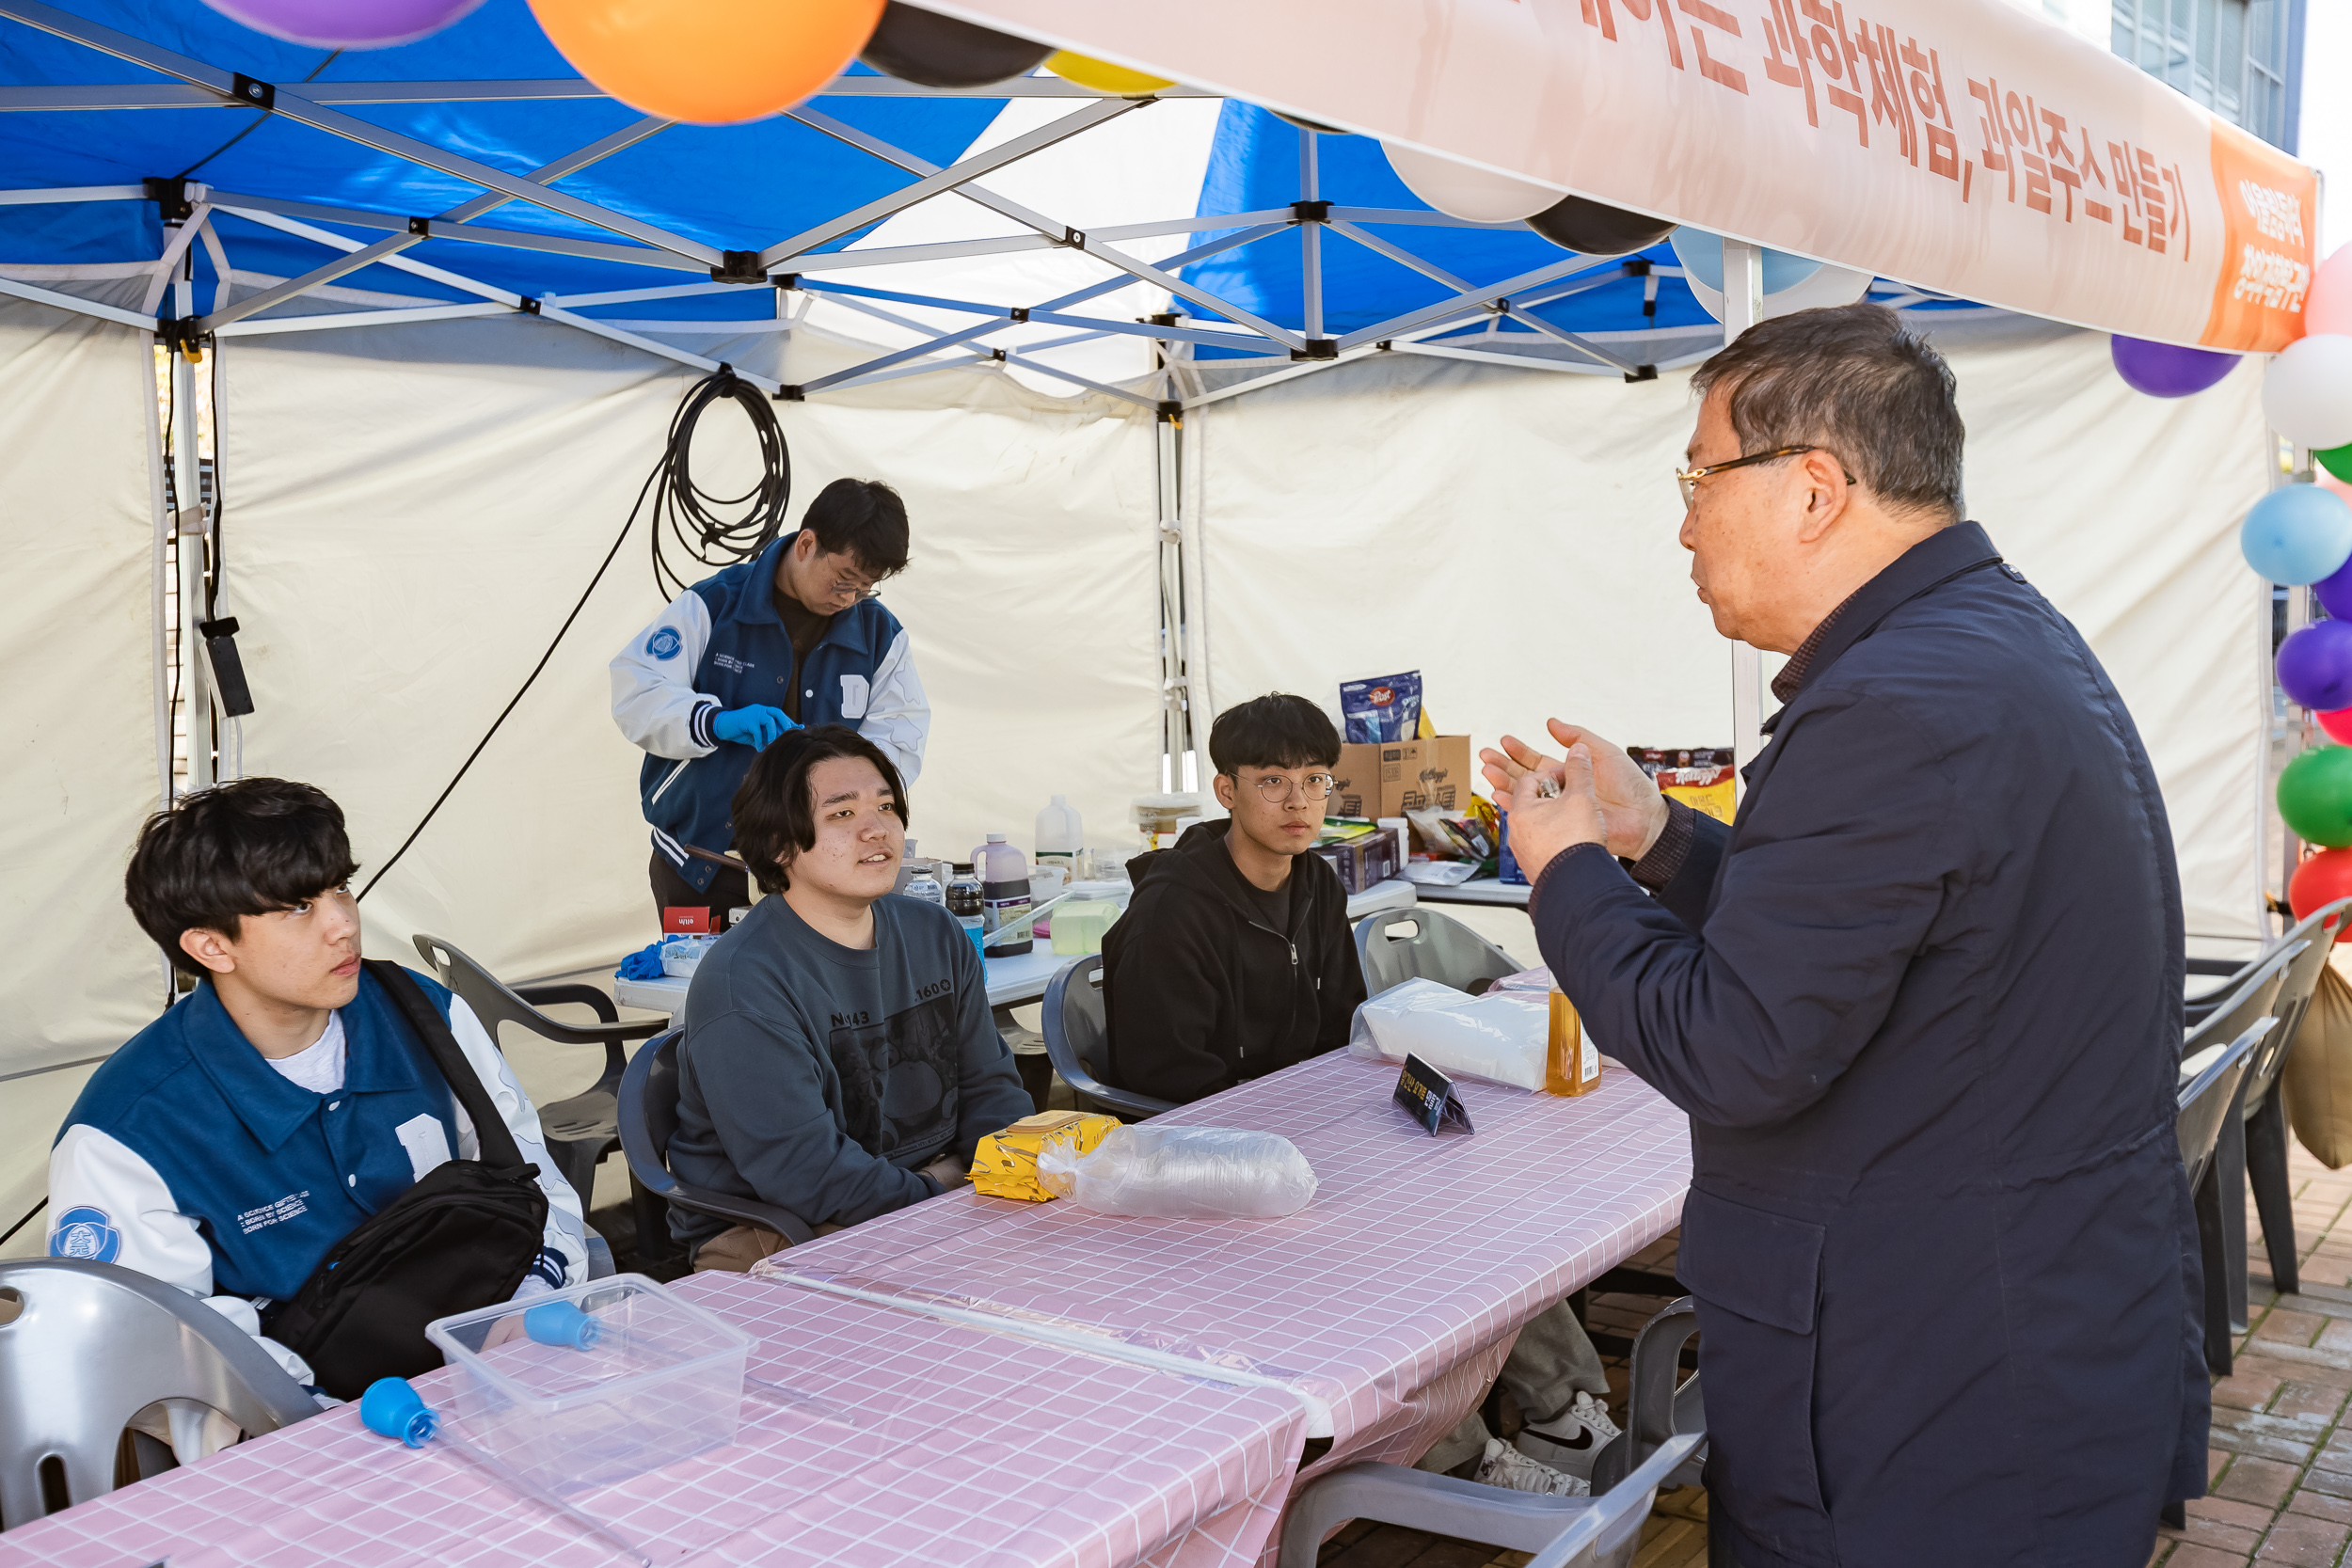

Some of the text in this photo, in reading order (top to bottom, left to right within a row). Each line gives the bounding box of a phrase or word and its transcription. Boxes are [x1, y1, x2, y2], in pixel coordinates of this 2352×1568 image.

[244, 1204, 275, 1218] SCIENCE
[275, 1195, 298, 1208] GIFTE
[276, 1199, 304, 1215] SCIENCE
[242, 1222, 263, 1235] BORN
[278, 1205, 308, 1222] SCIENCE
